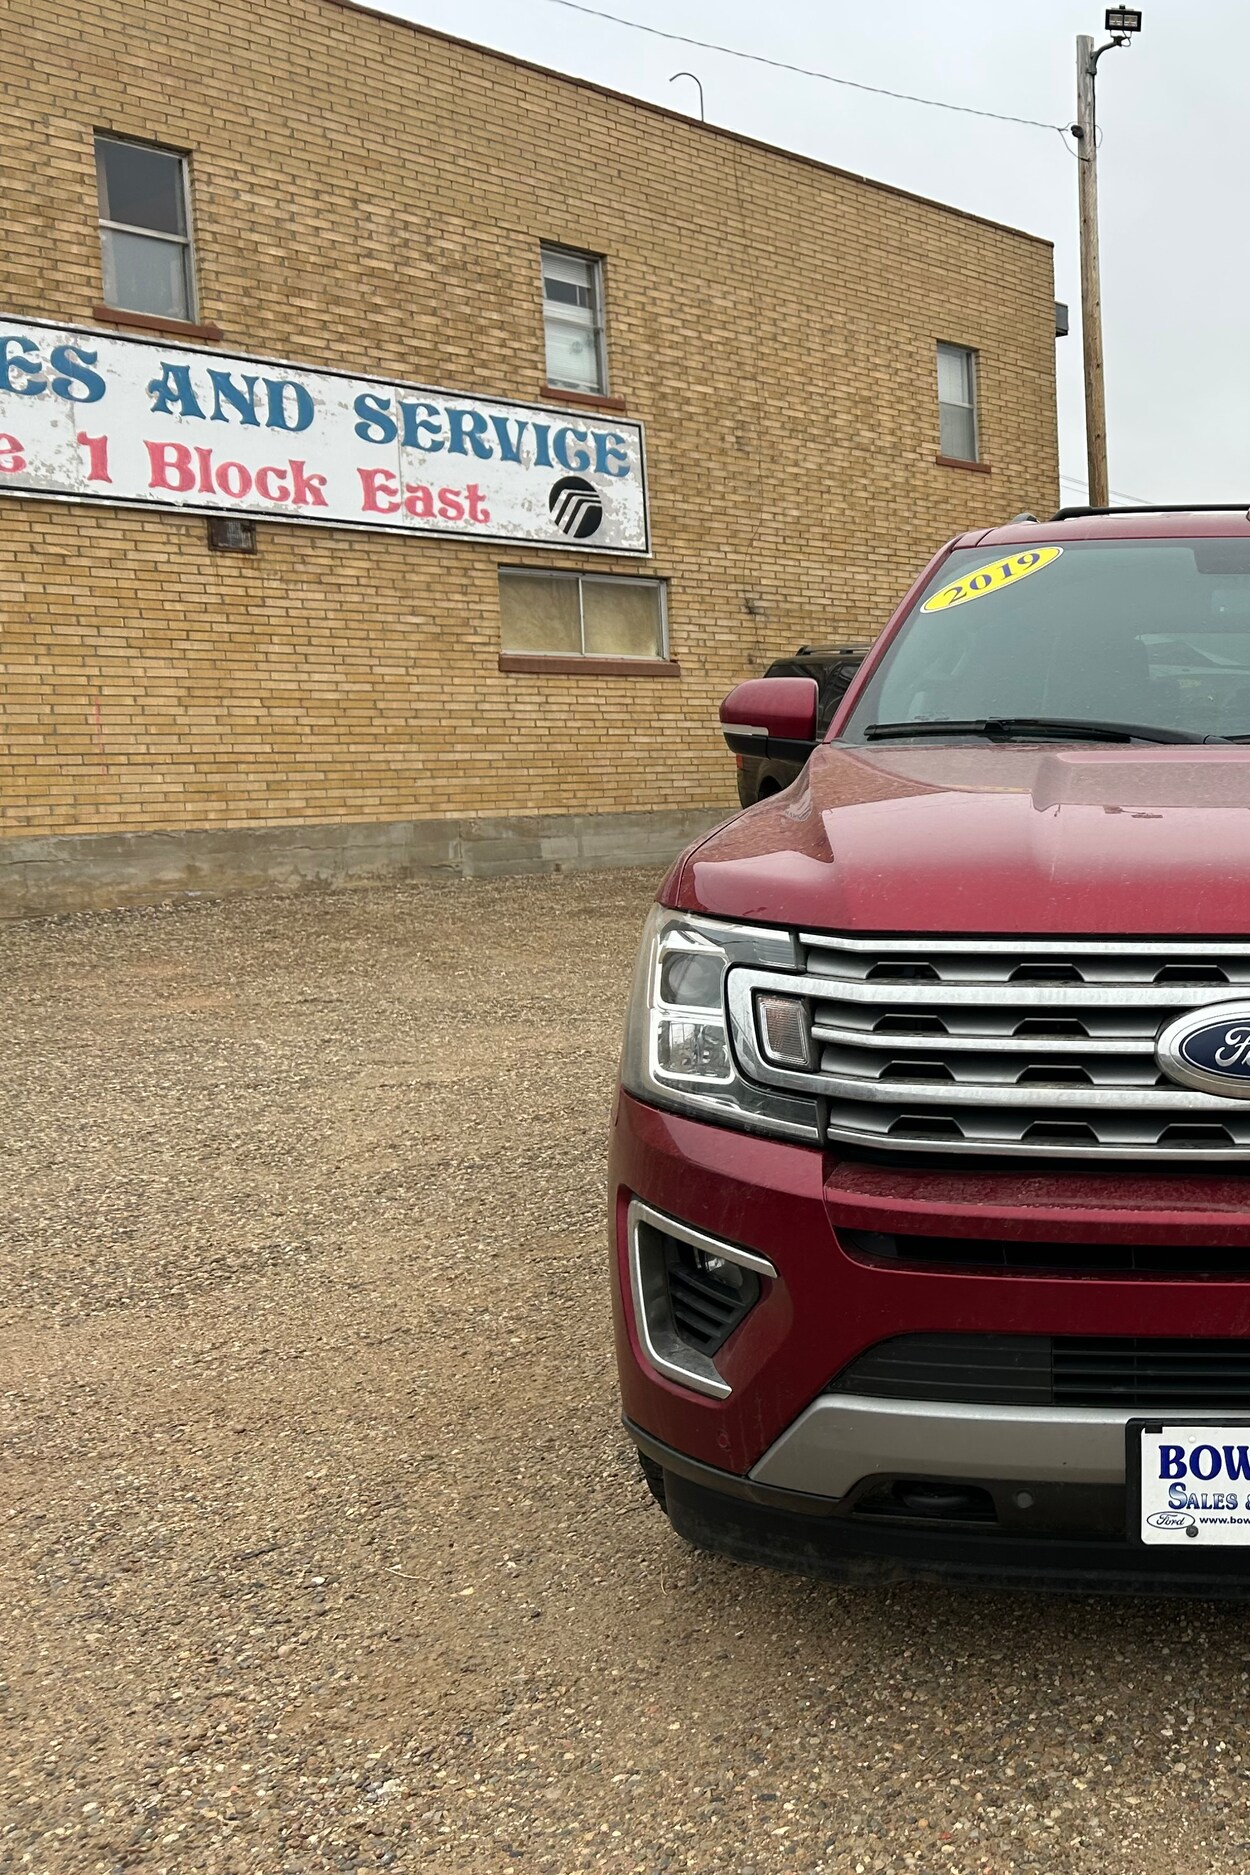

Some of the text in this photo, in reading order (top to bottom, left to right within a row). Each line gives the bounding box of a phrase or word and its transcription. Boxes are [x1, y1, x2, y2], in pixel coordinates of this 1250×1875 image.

[146, 361, 315, 432] AND
[354, 393, 632, 477] SERVICE
[144, 440, 328, 507] Block
[357, 467, 491, 524] East
[943, 552, 1040, 605] 2019
[1156, 1513, 1186, 1527] Ford
